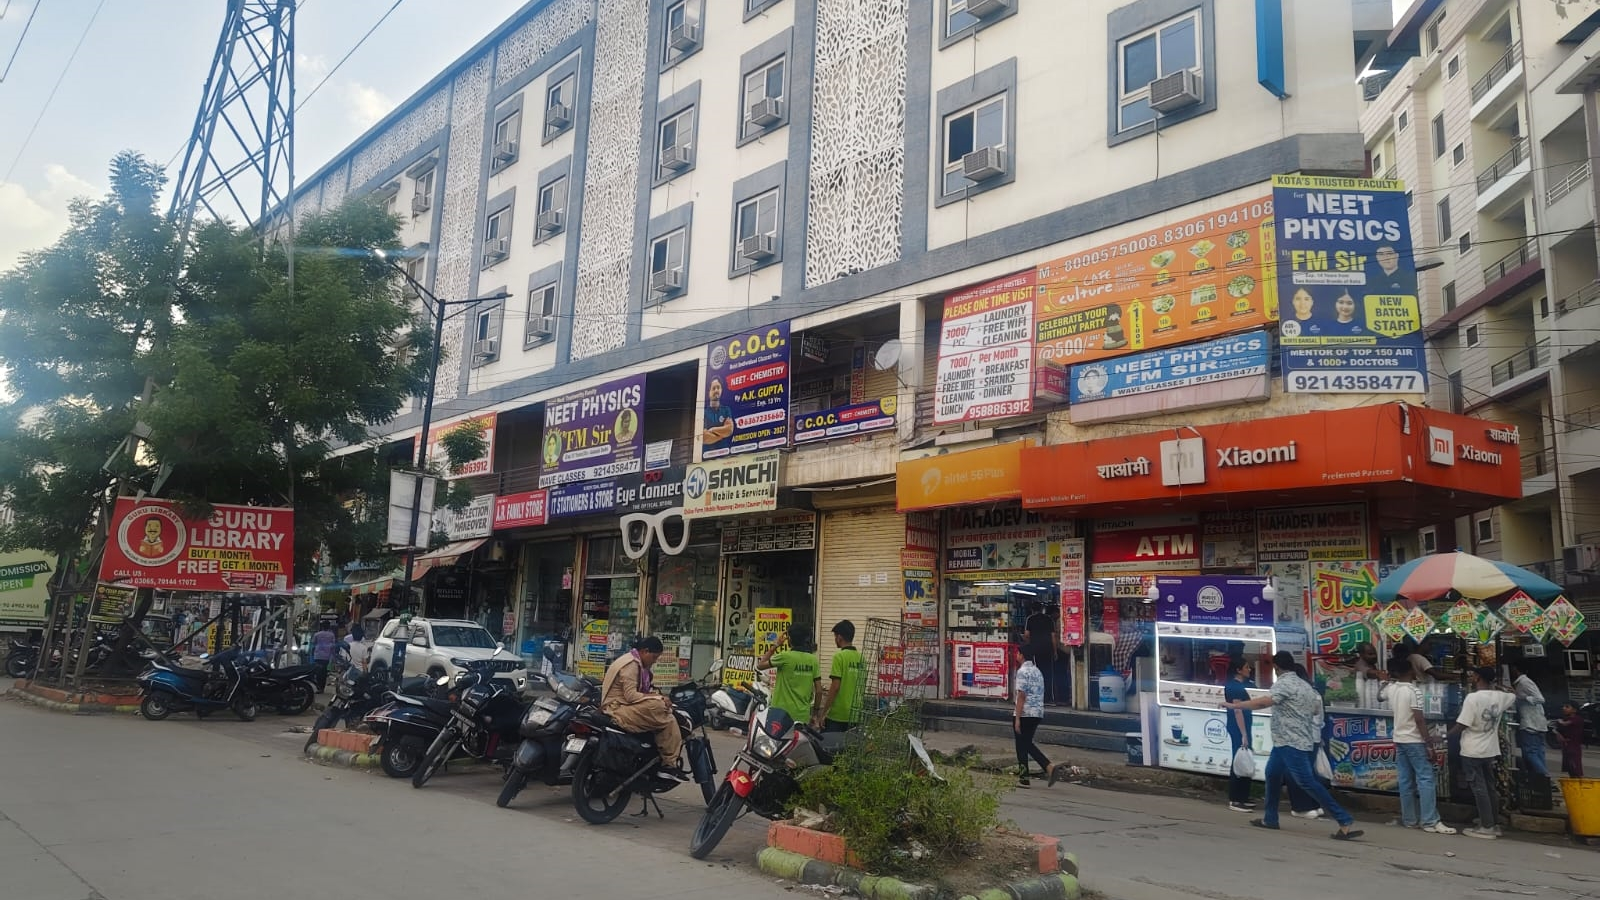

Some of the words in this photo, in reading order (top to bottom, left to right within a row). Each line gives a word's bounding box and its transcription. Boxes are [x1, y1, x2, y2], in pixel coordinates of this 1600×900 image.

[1278, 175, 1311, 186] KOTA'S
[1314, 178, 1355, 188] TRUSTED
[1358, 180, 1398, 189] FACULTY
[1306, 193, 1374, 215] NEET
[1284, 218, 1401, 242] PHYSICS
[1292, 249, 1328, 271] FM
[1335, 249, 1367, 271] Sir
[944, 301, 972, 319] PLEASE
[973, 298, 989, 312] ONE
[991, 293, 1010, 306] TIME
[1012, 286, 1034, 302] VISIT
[1058, 282, 1113, 305] culture
[1380, 297, 1402, 306] NEW
[984, 304, 1027, 323] LAUNDRY
[1039, 313, 1082, 331] CELEBRATE
[1084, 307, 1108, 321] YOUR
[1376, 308, 1409, 317] BATCH
[983, 321, 1006, 335] FREE
[1007, 316, 1027, 330] WIFI
[1038, 324, 1077, 341] BIRTHDAY
[1079, 318, 1106, 332] PARTY
[1374, 320, 1414, 331] START
[728, 328, 785, 360] C.O.C.
[982, 328, 1028, 346] CLEANING
[979, 352, 991, 363] Per
[993, 346, 1018, 360] Month
[1115, 356, 1164, 374] NEET
[1170, 338, 1262, 365] PHYSICS
[1395, 349, 1413, 357] AIR
[985, 358, 1029, 376] BREAKFAST
[1125, 369, 1162, 384] FM
[1171, 360, 1219, 376] SIR
[1307, 359, 1315, 367] &
[730, 377, 746, 386] NEET
[750, 366, 785, 381] CHEMISTRY
[943, 367, 976, 382] LAUNDRY
[984, 372, 1016, 388] SHANKS
[1118, 384, 1143, 395] WAVE
[1144, 379, 1185, 391] CLASSES
[1195, 367, 1259, 383] 9214358477
[1295, 375, 1417, 390] 9214358477
[741, 390, 757, 402] A.K.
[757, 384, 784, 398] GUPTA
[942, 382, 959, 393] FREE
[960, 379, 975, 390] WIFI
[983, 385, 1013, 399] DINNER
[545, 401, 578, 427] NEET
[581, 384, 641, 419] PHYSICS
[941, 391, 975, 405] CLEANING
[940, 403, 964, 416] LUNCH
[969, 400, 1030, 419] 9588863912
[804, 413, 838, 429] C.O.C.
[731, 431, 757, 443] ADMISSION
[757, 429, 771, 438] OPEN
[1489, 426, 1520, 445] शाओमी
[1216, 440, 1296, 468] Xiaomi
[1461, 444, 1502, 466] Xiaomi
[556, 470, 586, 484] CLASSES
[593, 461, 638, 477] 9214358477
[708, 461, 777, 490] SANCHI
[943, 469, 968, 484] airtel
[1096, 456, 1149, 479] शाओमी
[1321, 470, 1360, 481] Preferred
[1362, 468, 1394, 479] Partner
[556, 492, 589, 514] STATIONERS
[595, 489, 614, 509] STORE
[616, 486, 636, 507] Eye
[712, 490, 734, 502] Mobile
[736, 491, 740, 499] &
[742, 488, 769, 498] Services
[506, 502, 525, 520] FAMILY
[525, 499, 543, 518] STORE
[208, 509, 273, 531] GURU
[454, 518, 487, 533] MAKEOVER
[1259, 514, 1314, 531] MAHADEV
[190, 527, 285, 550] LIBRARY
[1135, 533, 1194, 557] ATM
[191, 550, 209, 559] BUY
[212, 551, 217, 559] 1
[219, 550, 250, 560] MONTH
[953, 549, 977, 558] MOBILE
[1312, 550, 1330, 559] MOBILE
[0, 562, 48, 578] DMISSION
[177, 560, 219, 574] FREE
[222, 561, 240, 570] GET
[242, 562, 247, 570] 1
[249, 562, 279, 571] MONTH
[948, 559, 981, 569] REPAIRING
[1115, 576, 1141, 585] ZEROX
[1115, 586, 1142, 595] P.D.F.
[1319, 619, 1334, 630] का
[727, 655, 754, 670] COURIER
[1332, 717, 1370, 738] ताजा
